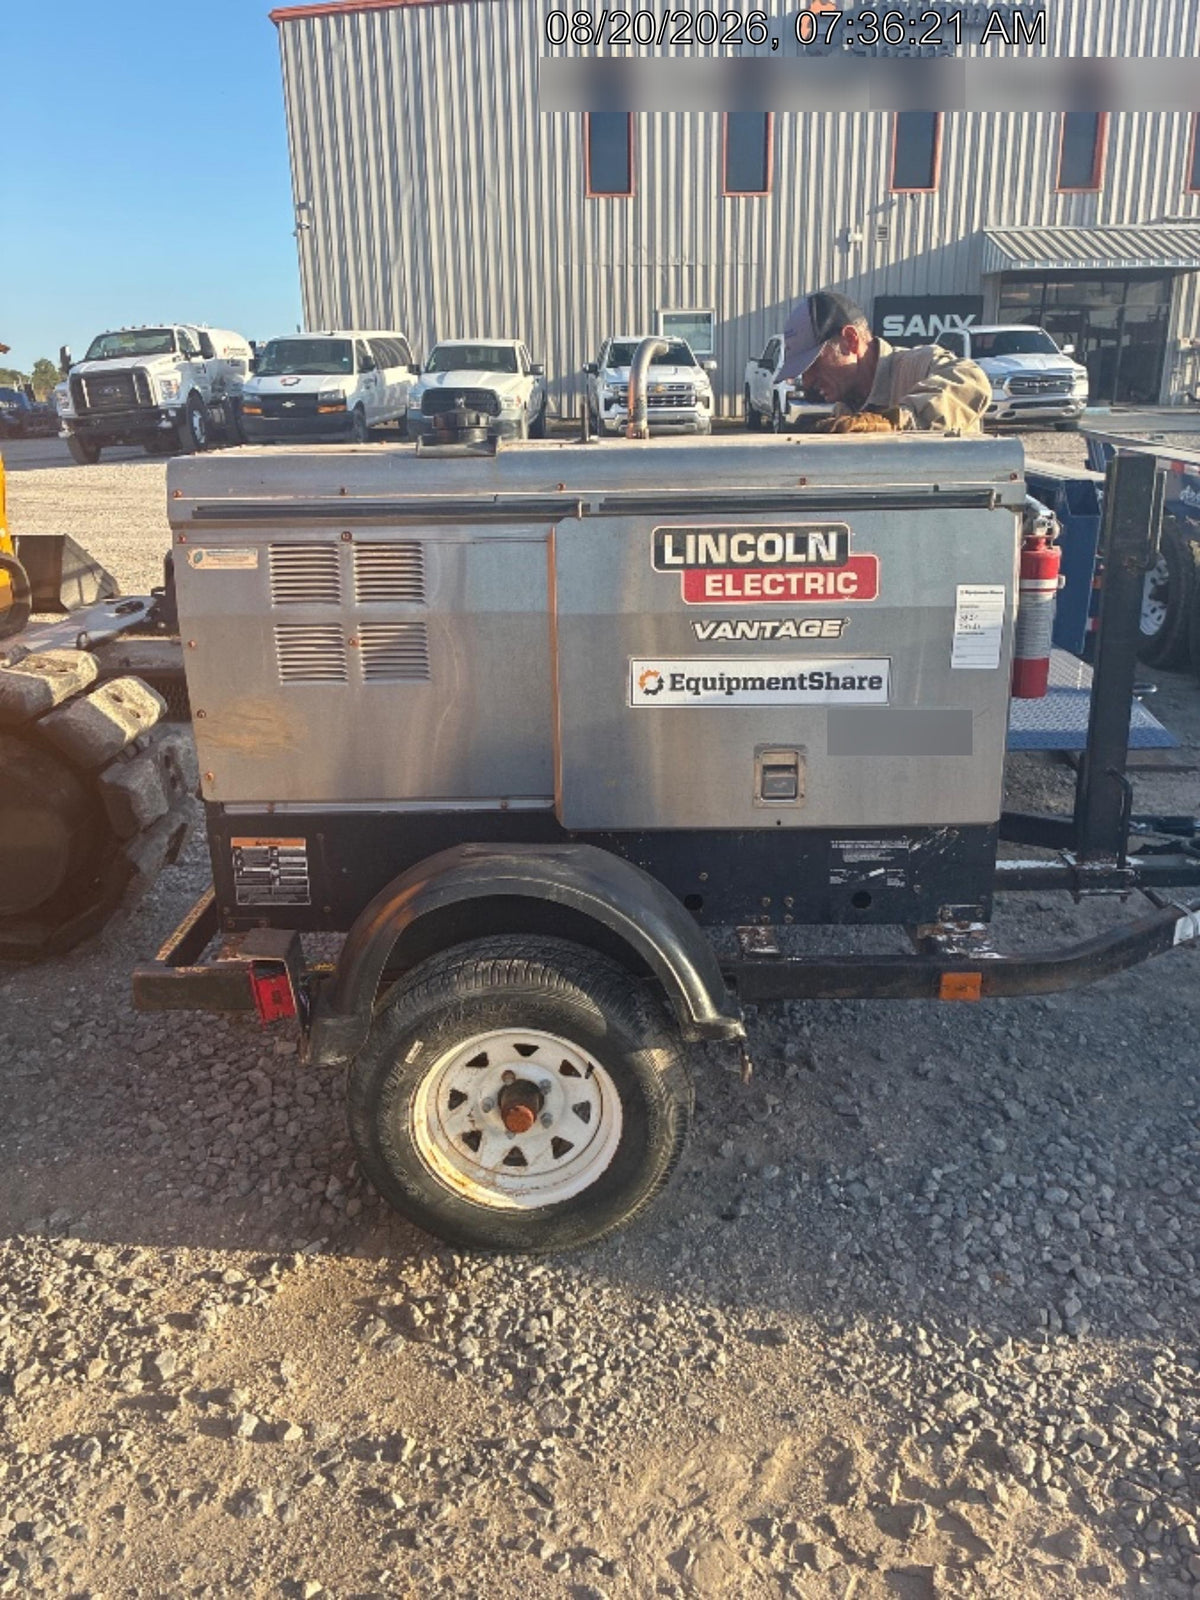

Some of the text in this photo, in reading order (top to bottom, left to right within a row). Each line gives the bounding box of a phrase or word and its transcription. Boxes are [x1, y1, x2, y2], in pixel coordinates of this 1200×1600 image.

[882, 314, 977, 337] SANY
[663, 531, 838, 565] LINCOLN
[705, 571, 859, 597] ELECTRIC
[691, 618, 846, 641] VANTAGE
[669, 671, 883, 696] EquipmentShare
